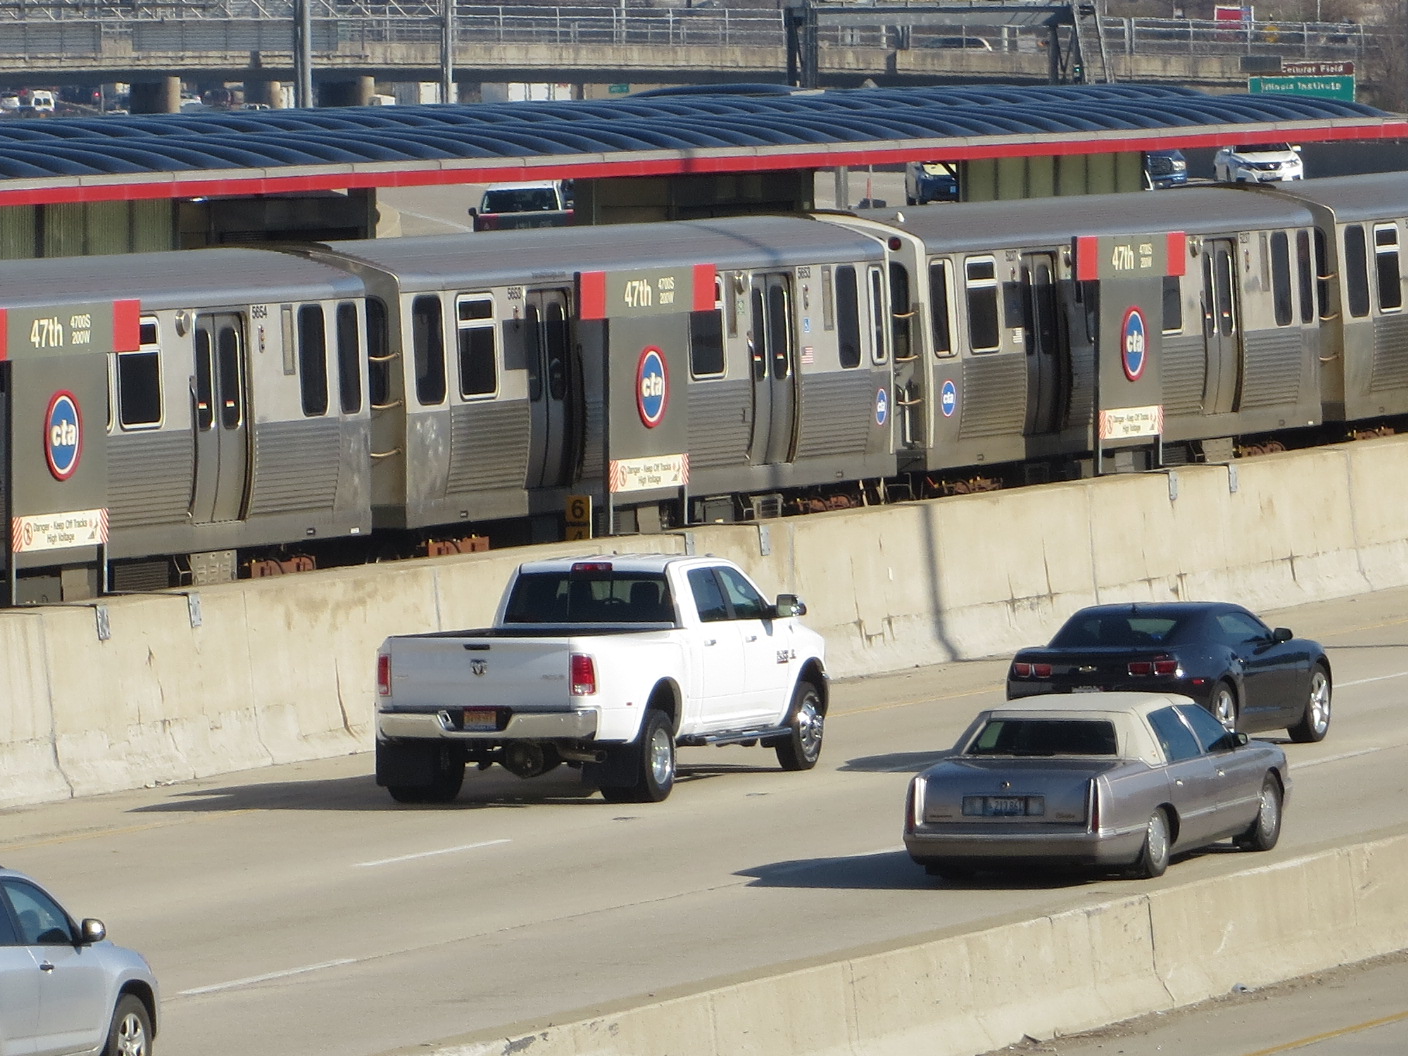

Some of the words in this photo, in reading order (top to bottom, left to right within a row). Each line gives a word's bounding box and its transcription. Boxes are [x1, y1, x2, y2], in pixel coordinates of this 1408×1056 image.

[1319, 64, 1344, 72] Field
[1297, 82, 1342, 91] Institute
[1112, 244, 1134, 271] 47th
[624, 279, 652, 307] 47th
[30, 316, 63, 348] 47th
[70, 313, 91, 328] 4700S
[71, 330, 91, 345] 200W
[1126, 330, 1143, 353] cta
[641, 372, 663, 397] cta
[50, 419, 76, 447] cta
[572, 499, 584, 519] 6
